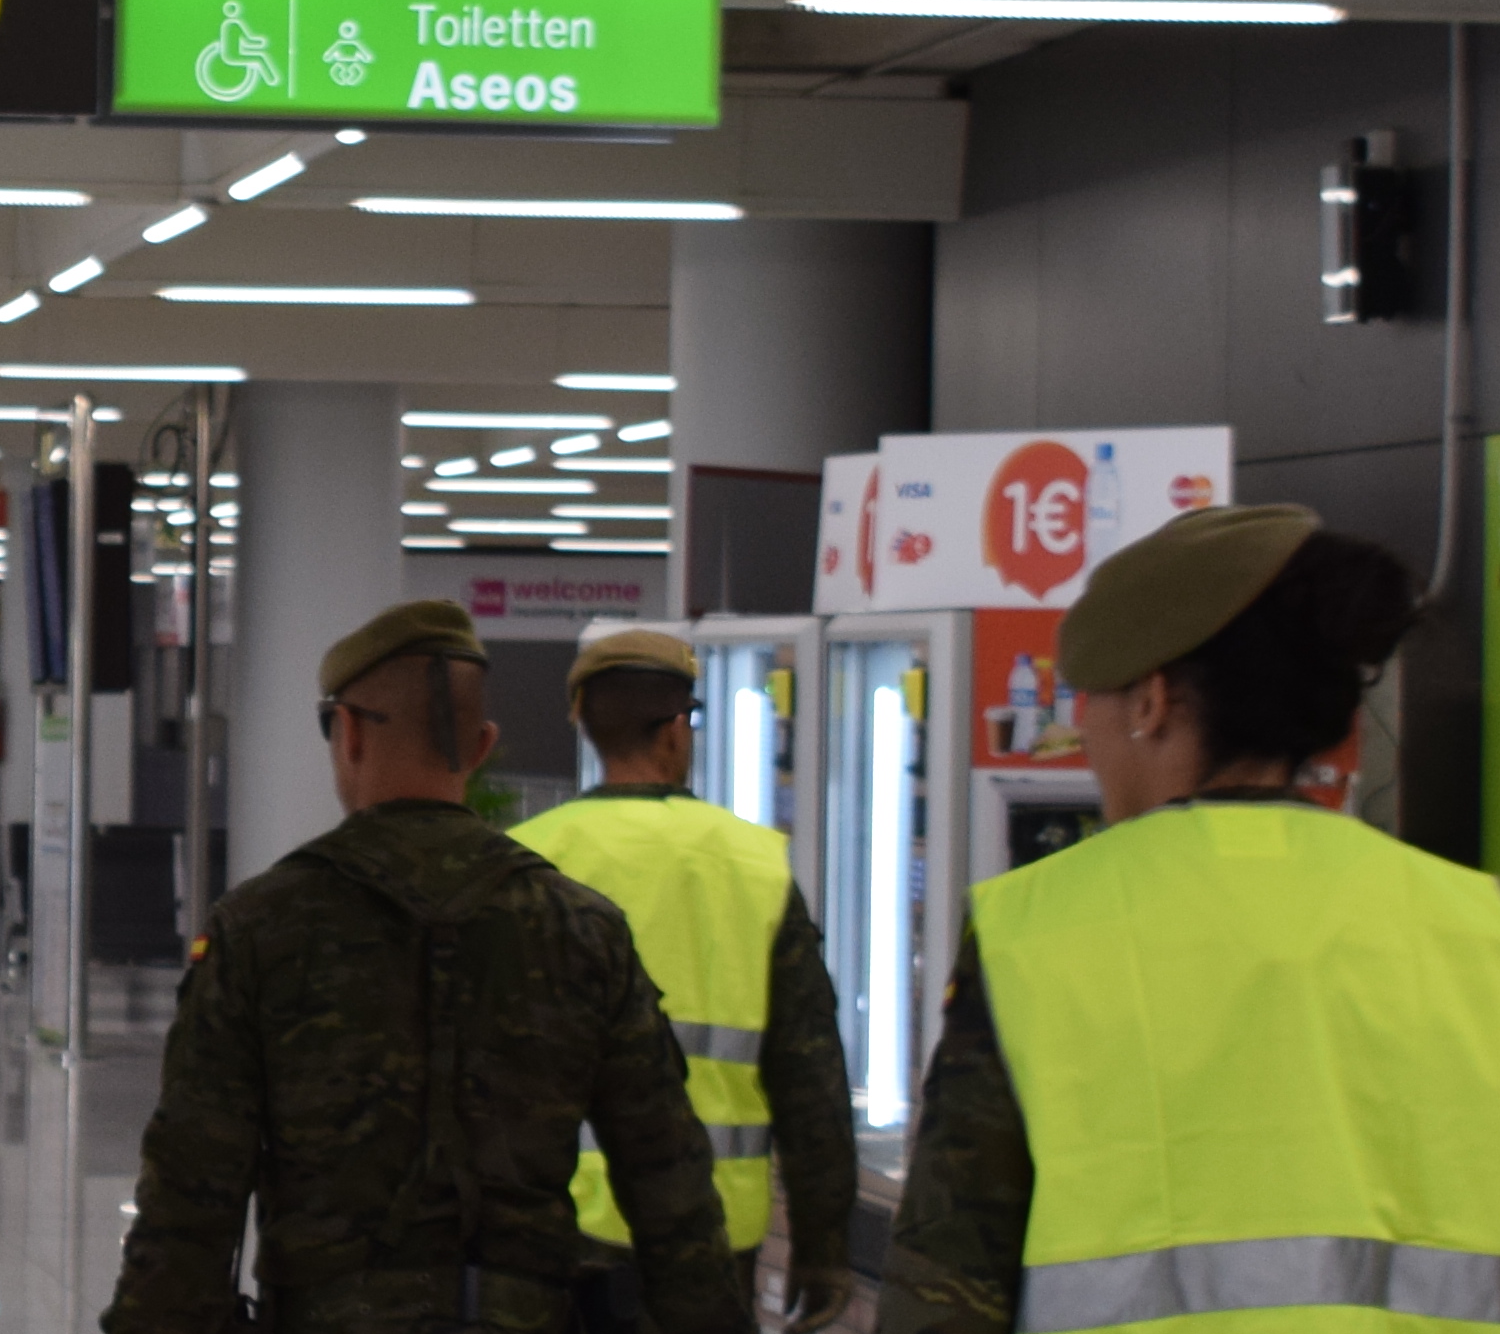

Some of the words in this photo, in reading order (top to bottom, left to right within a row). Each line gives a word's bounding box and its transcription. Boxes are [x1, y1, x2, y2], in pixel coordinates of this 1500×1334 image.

[408, 2, 596, 49] Toiletten
[407, 60, 579, 112] Aseos
[896, 483, 932, 498] VISA
[1003, 479, 1081, 555] 1€
[513, 578, 641, 602] welcome
